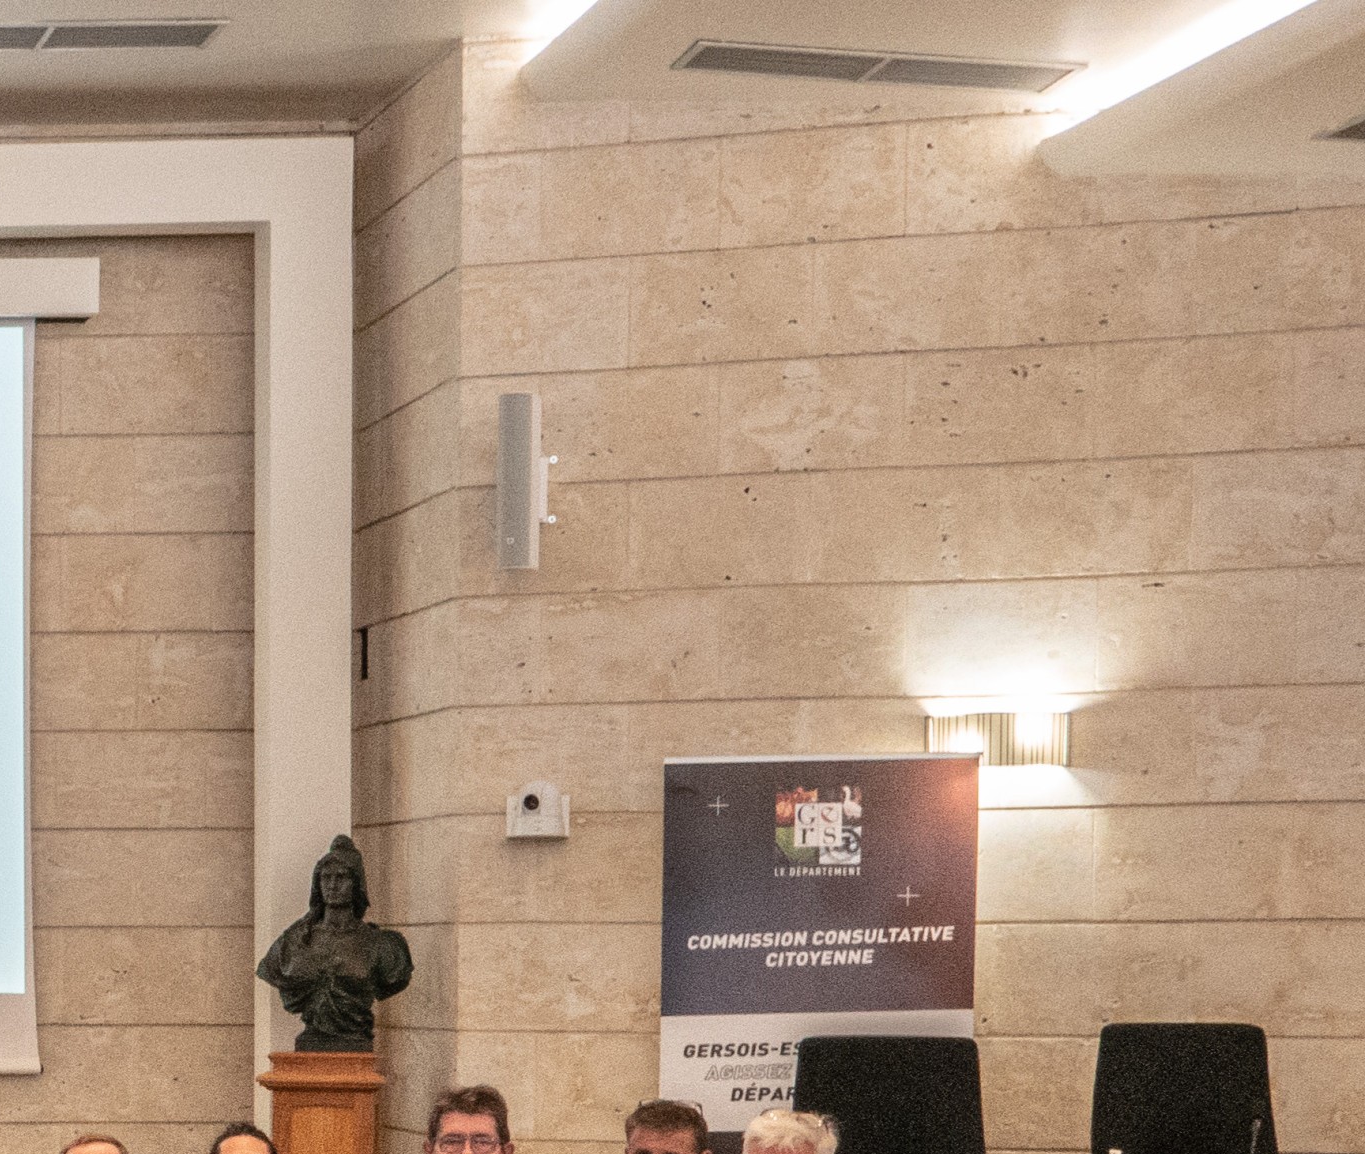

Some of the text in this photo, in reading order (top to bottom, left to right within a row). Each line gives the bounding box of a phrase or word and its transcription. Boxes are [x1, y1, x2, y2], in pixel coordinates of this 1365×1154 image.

[789, 866, 861, 876] DÉPARTEMENT
[687, 926, 955, 951] COMMISSION CONSULTATIVE
[765, 949, 875, 968] CITOYENNE
[704, 1064, 794, 1081] AGISSEZ
